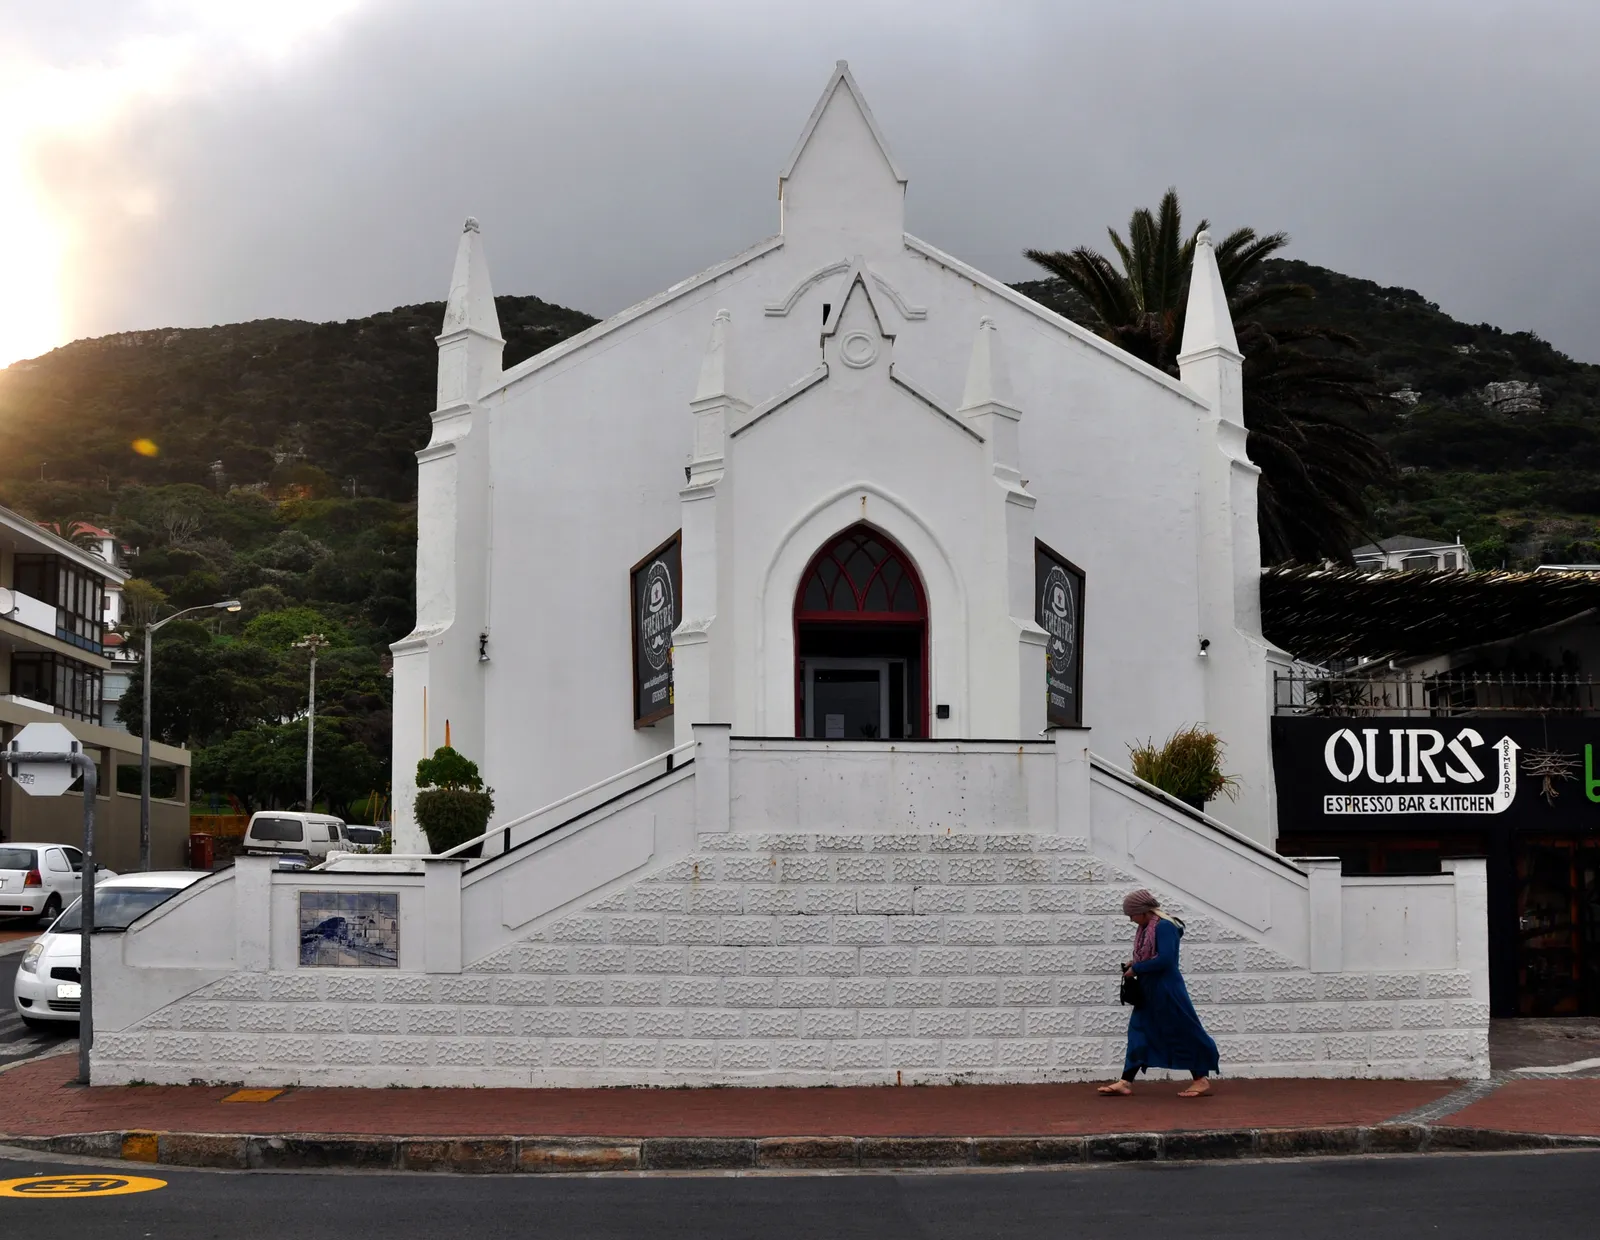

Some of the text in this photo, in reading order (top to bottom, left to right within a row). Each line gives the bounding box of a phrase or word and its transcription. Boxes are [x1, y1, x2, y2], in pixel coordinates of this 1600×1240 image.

[643, 603, 673, 639] THEATRE
[1044, 608, 1073, 645] THEATRE
[1324, 727, 1485, 783] OURS
[1326, 796, 1494, 813] ESPRESSO BAR & KITCHEN
